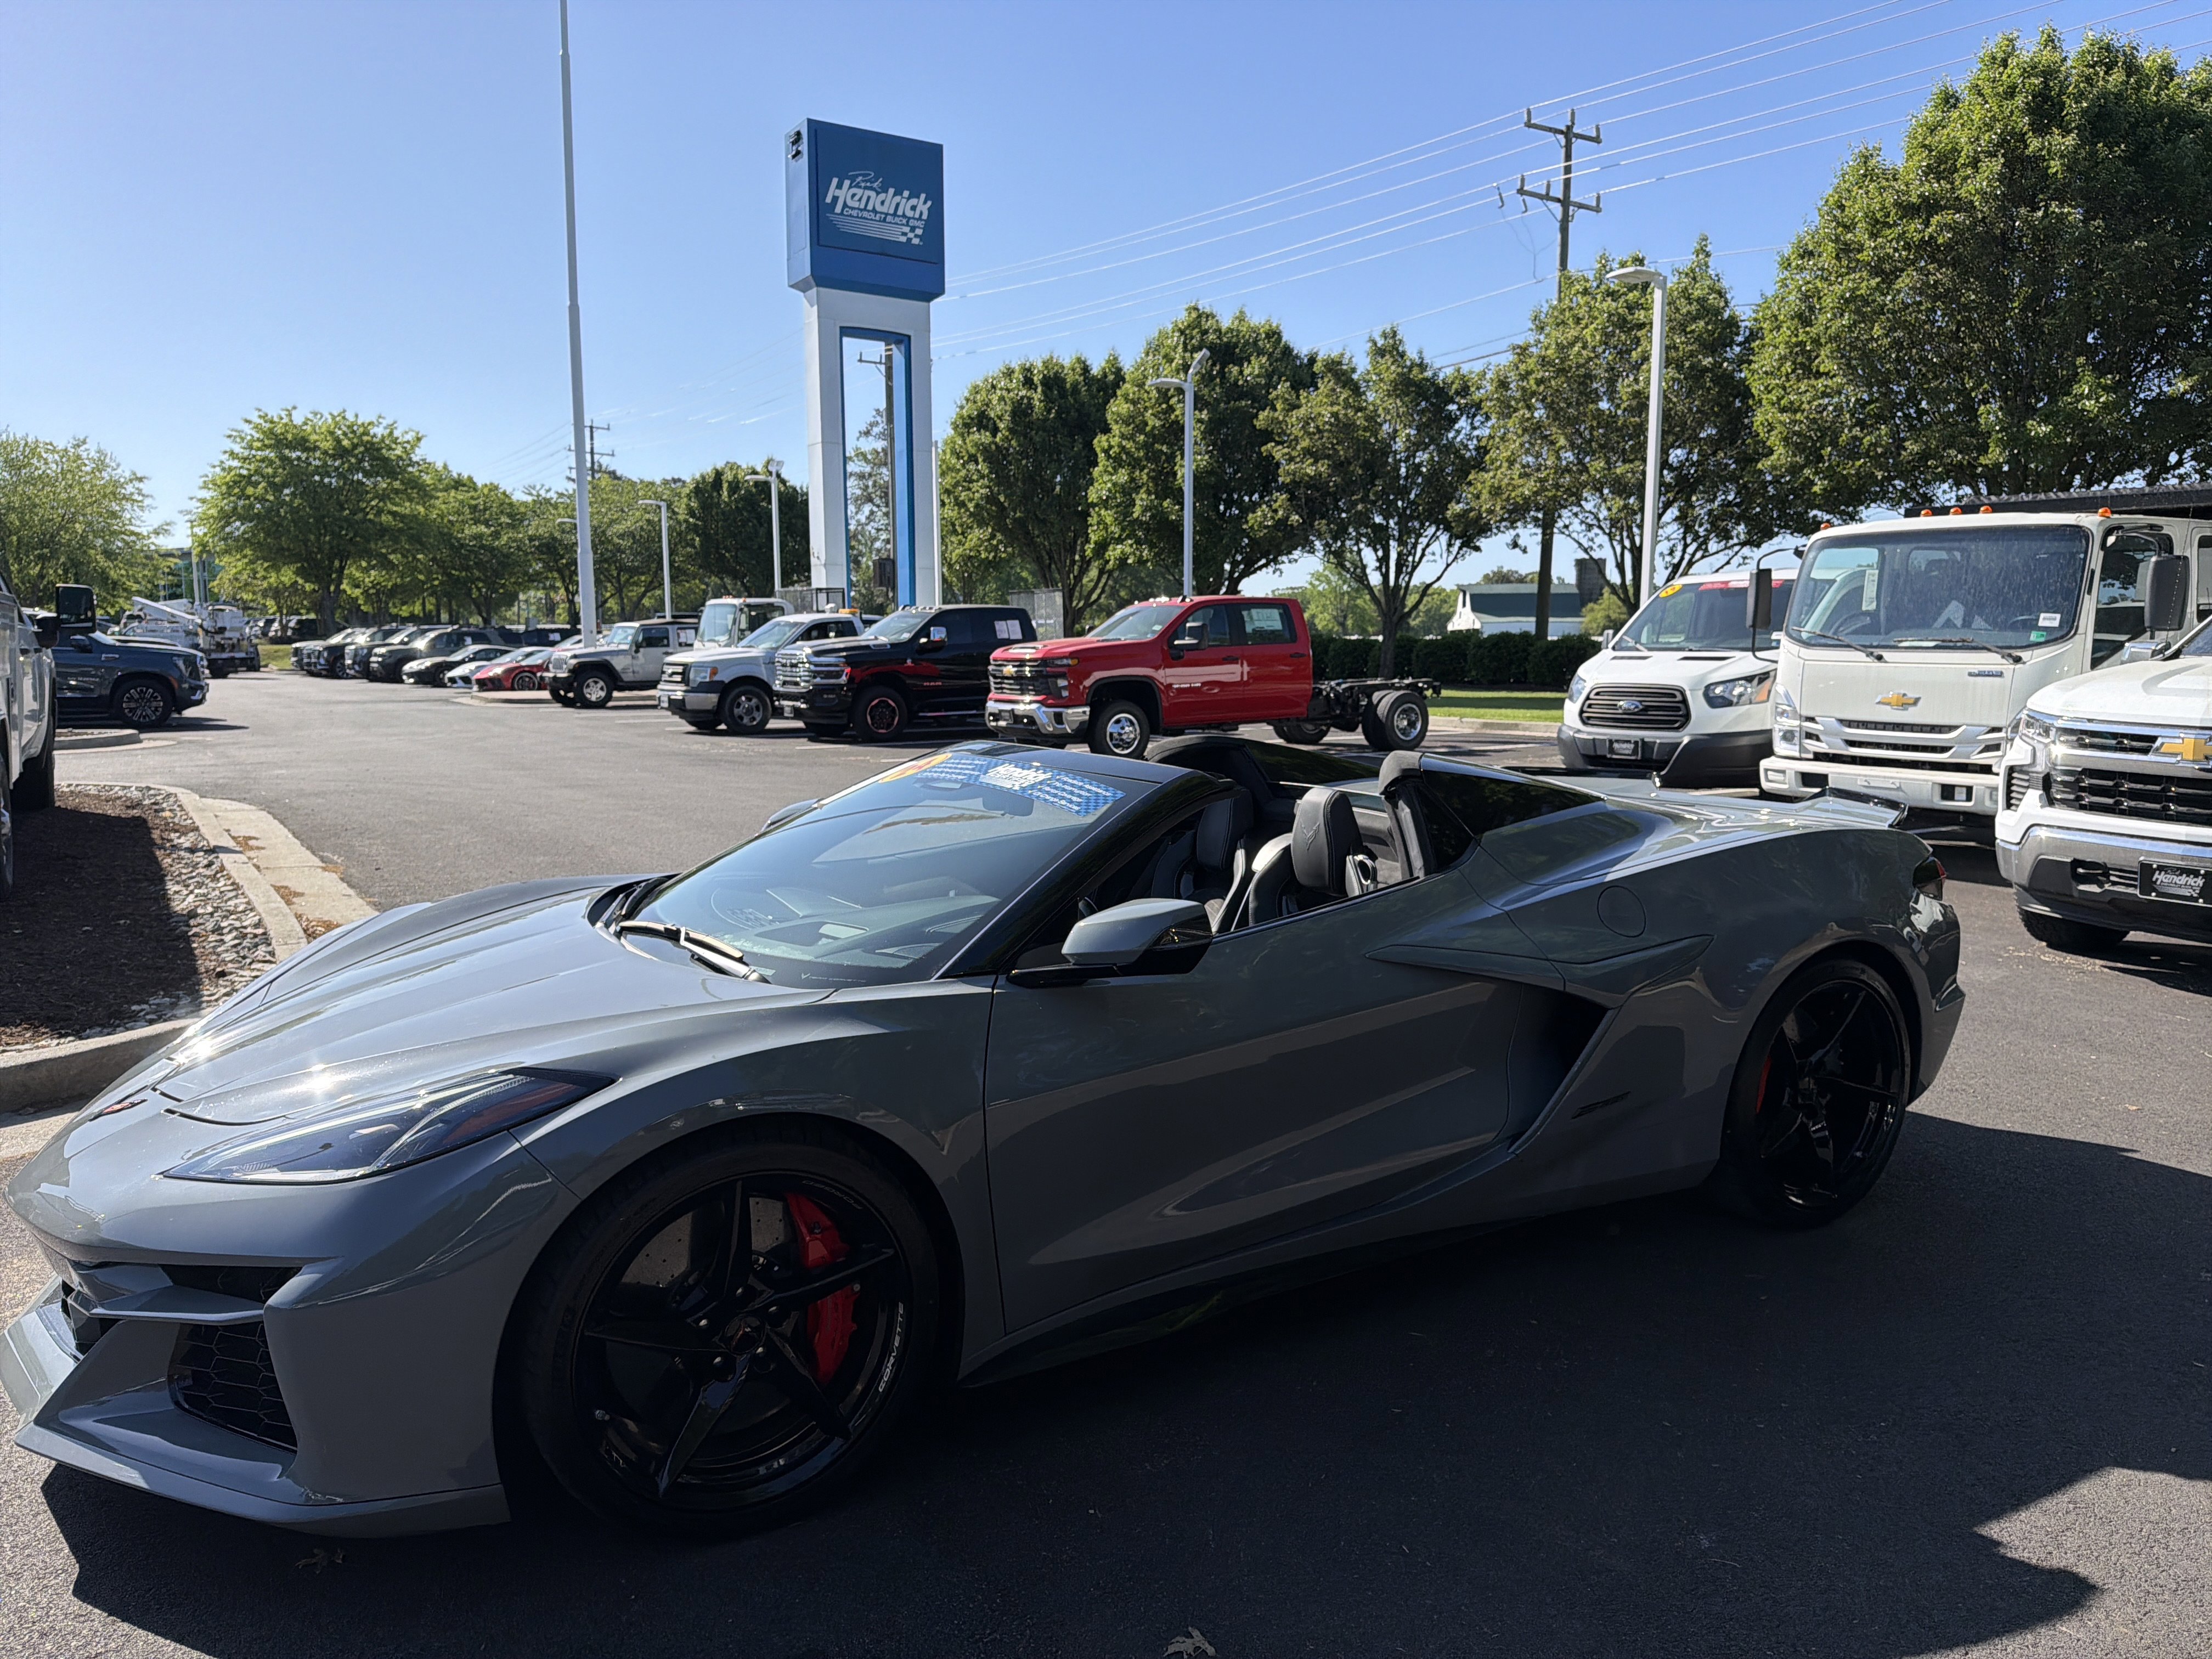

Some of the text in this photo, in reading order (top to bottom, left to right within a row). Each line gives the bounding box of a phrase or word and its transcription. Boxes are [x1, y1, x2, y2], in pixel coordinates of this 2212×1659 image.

[825, 177, 932, 219] Hendrick
[843, 208, 885, 221] CHEVROLET
[886, 216, 908, 225] BUICK
[2152, 870, 2205, 887] Hendrick
[802, 1180, 864, 1209] FORGED
[878, 1300, 904, 1392] CORVETTE
